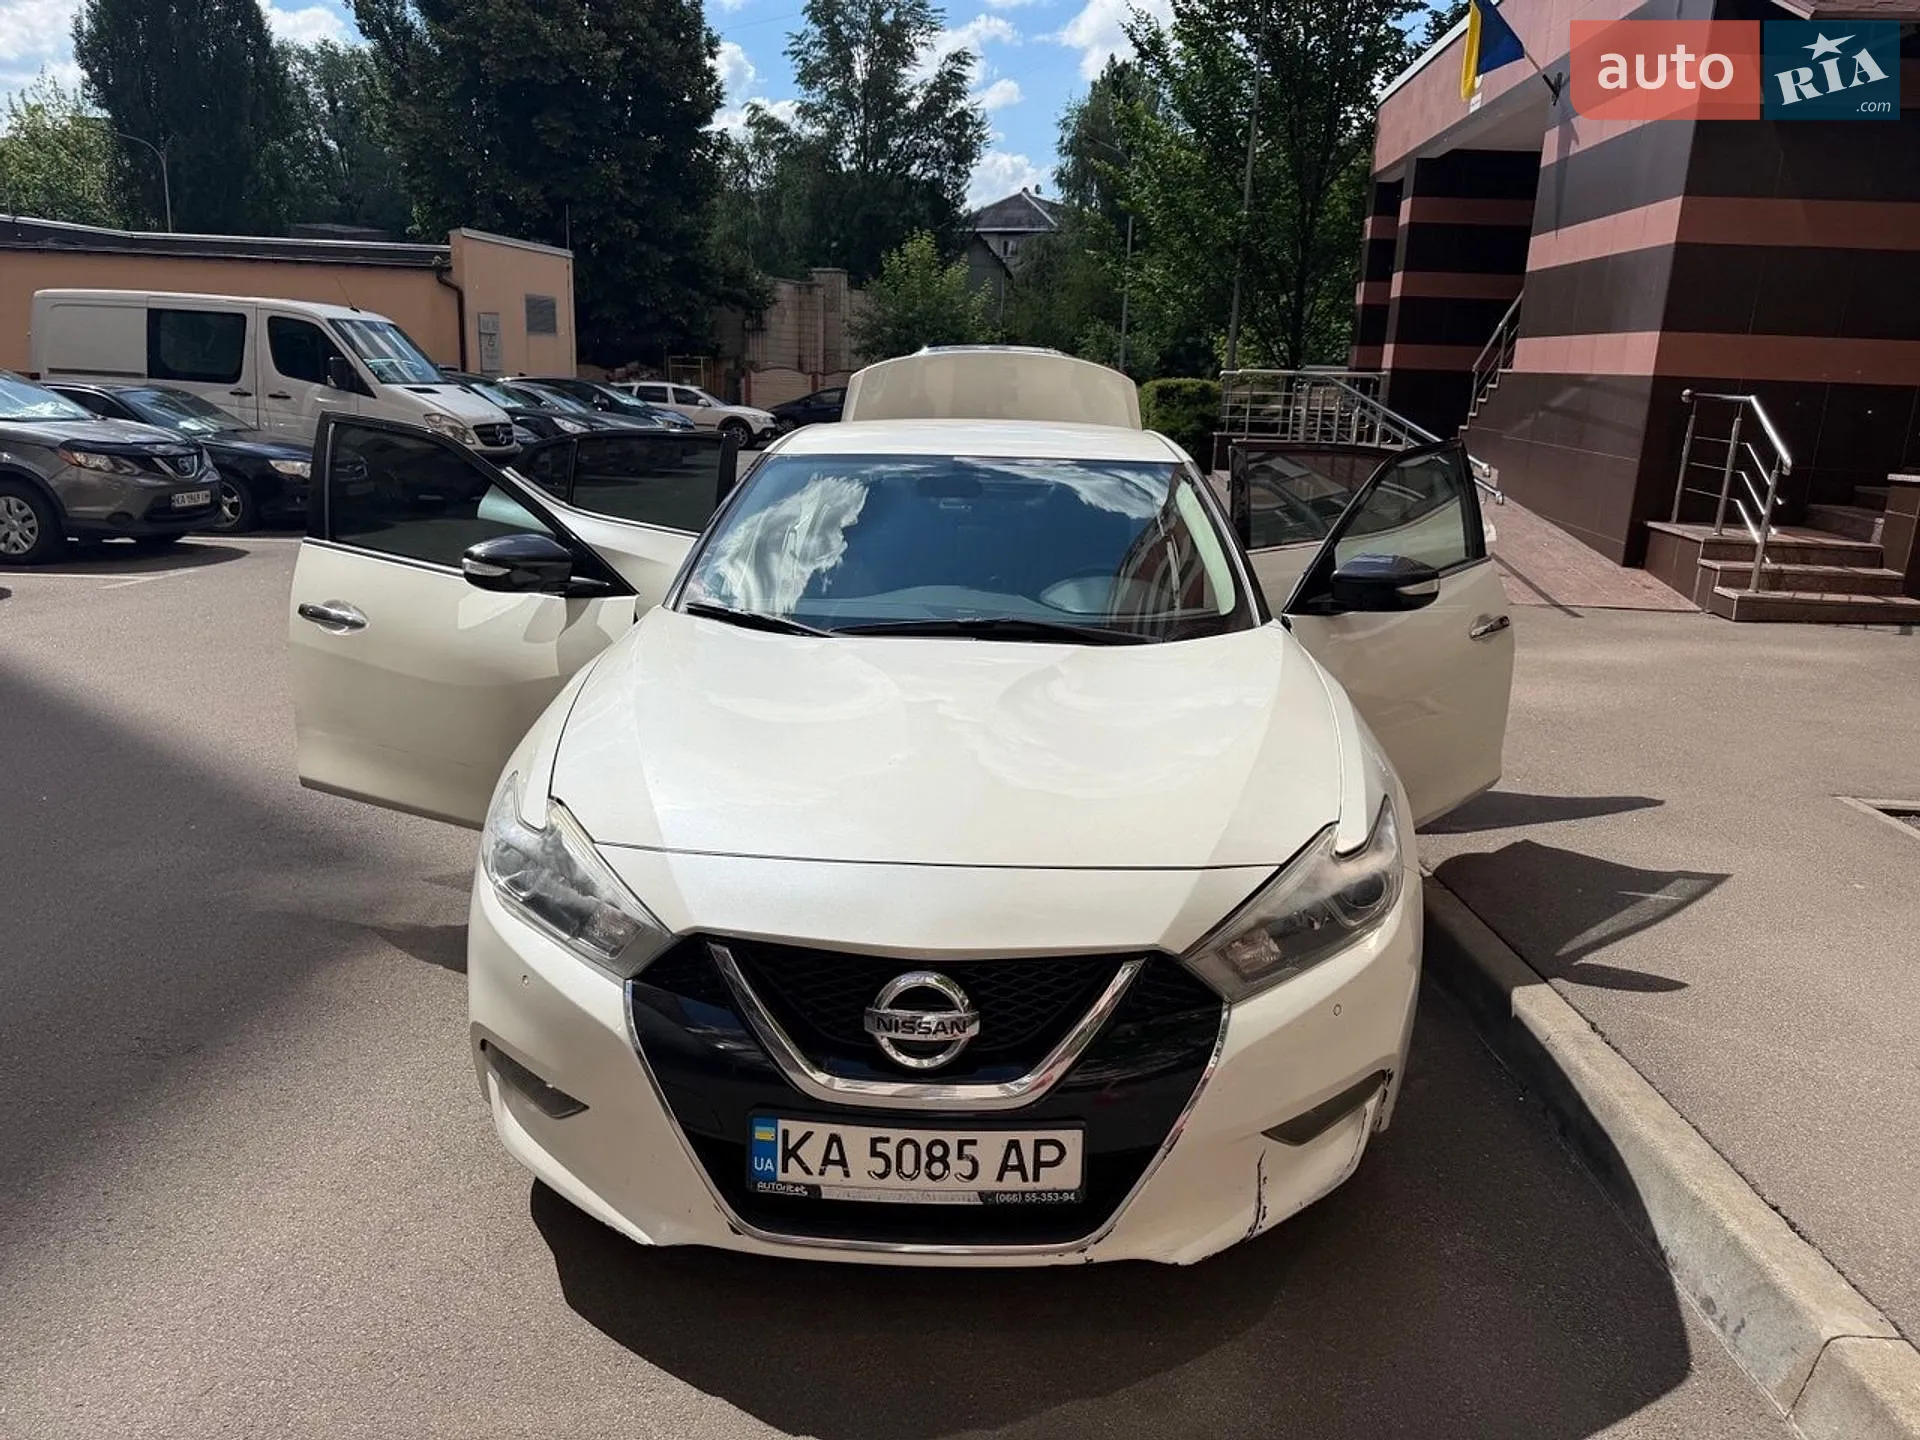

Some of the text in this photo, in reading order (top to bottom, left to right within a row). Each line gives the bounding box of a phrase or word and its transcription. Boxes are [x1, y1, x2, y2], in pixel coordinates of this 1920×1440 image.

[876, 1016, 966, 1035] NISSAN
[754, 1157, 774, 1172] UA
[781, 1128, 1067, 1183] KA 5085 AP
